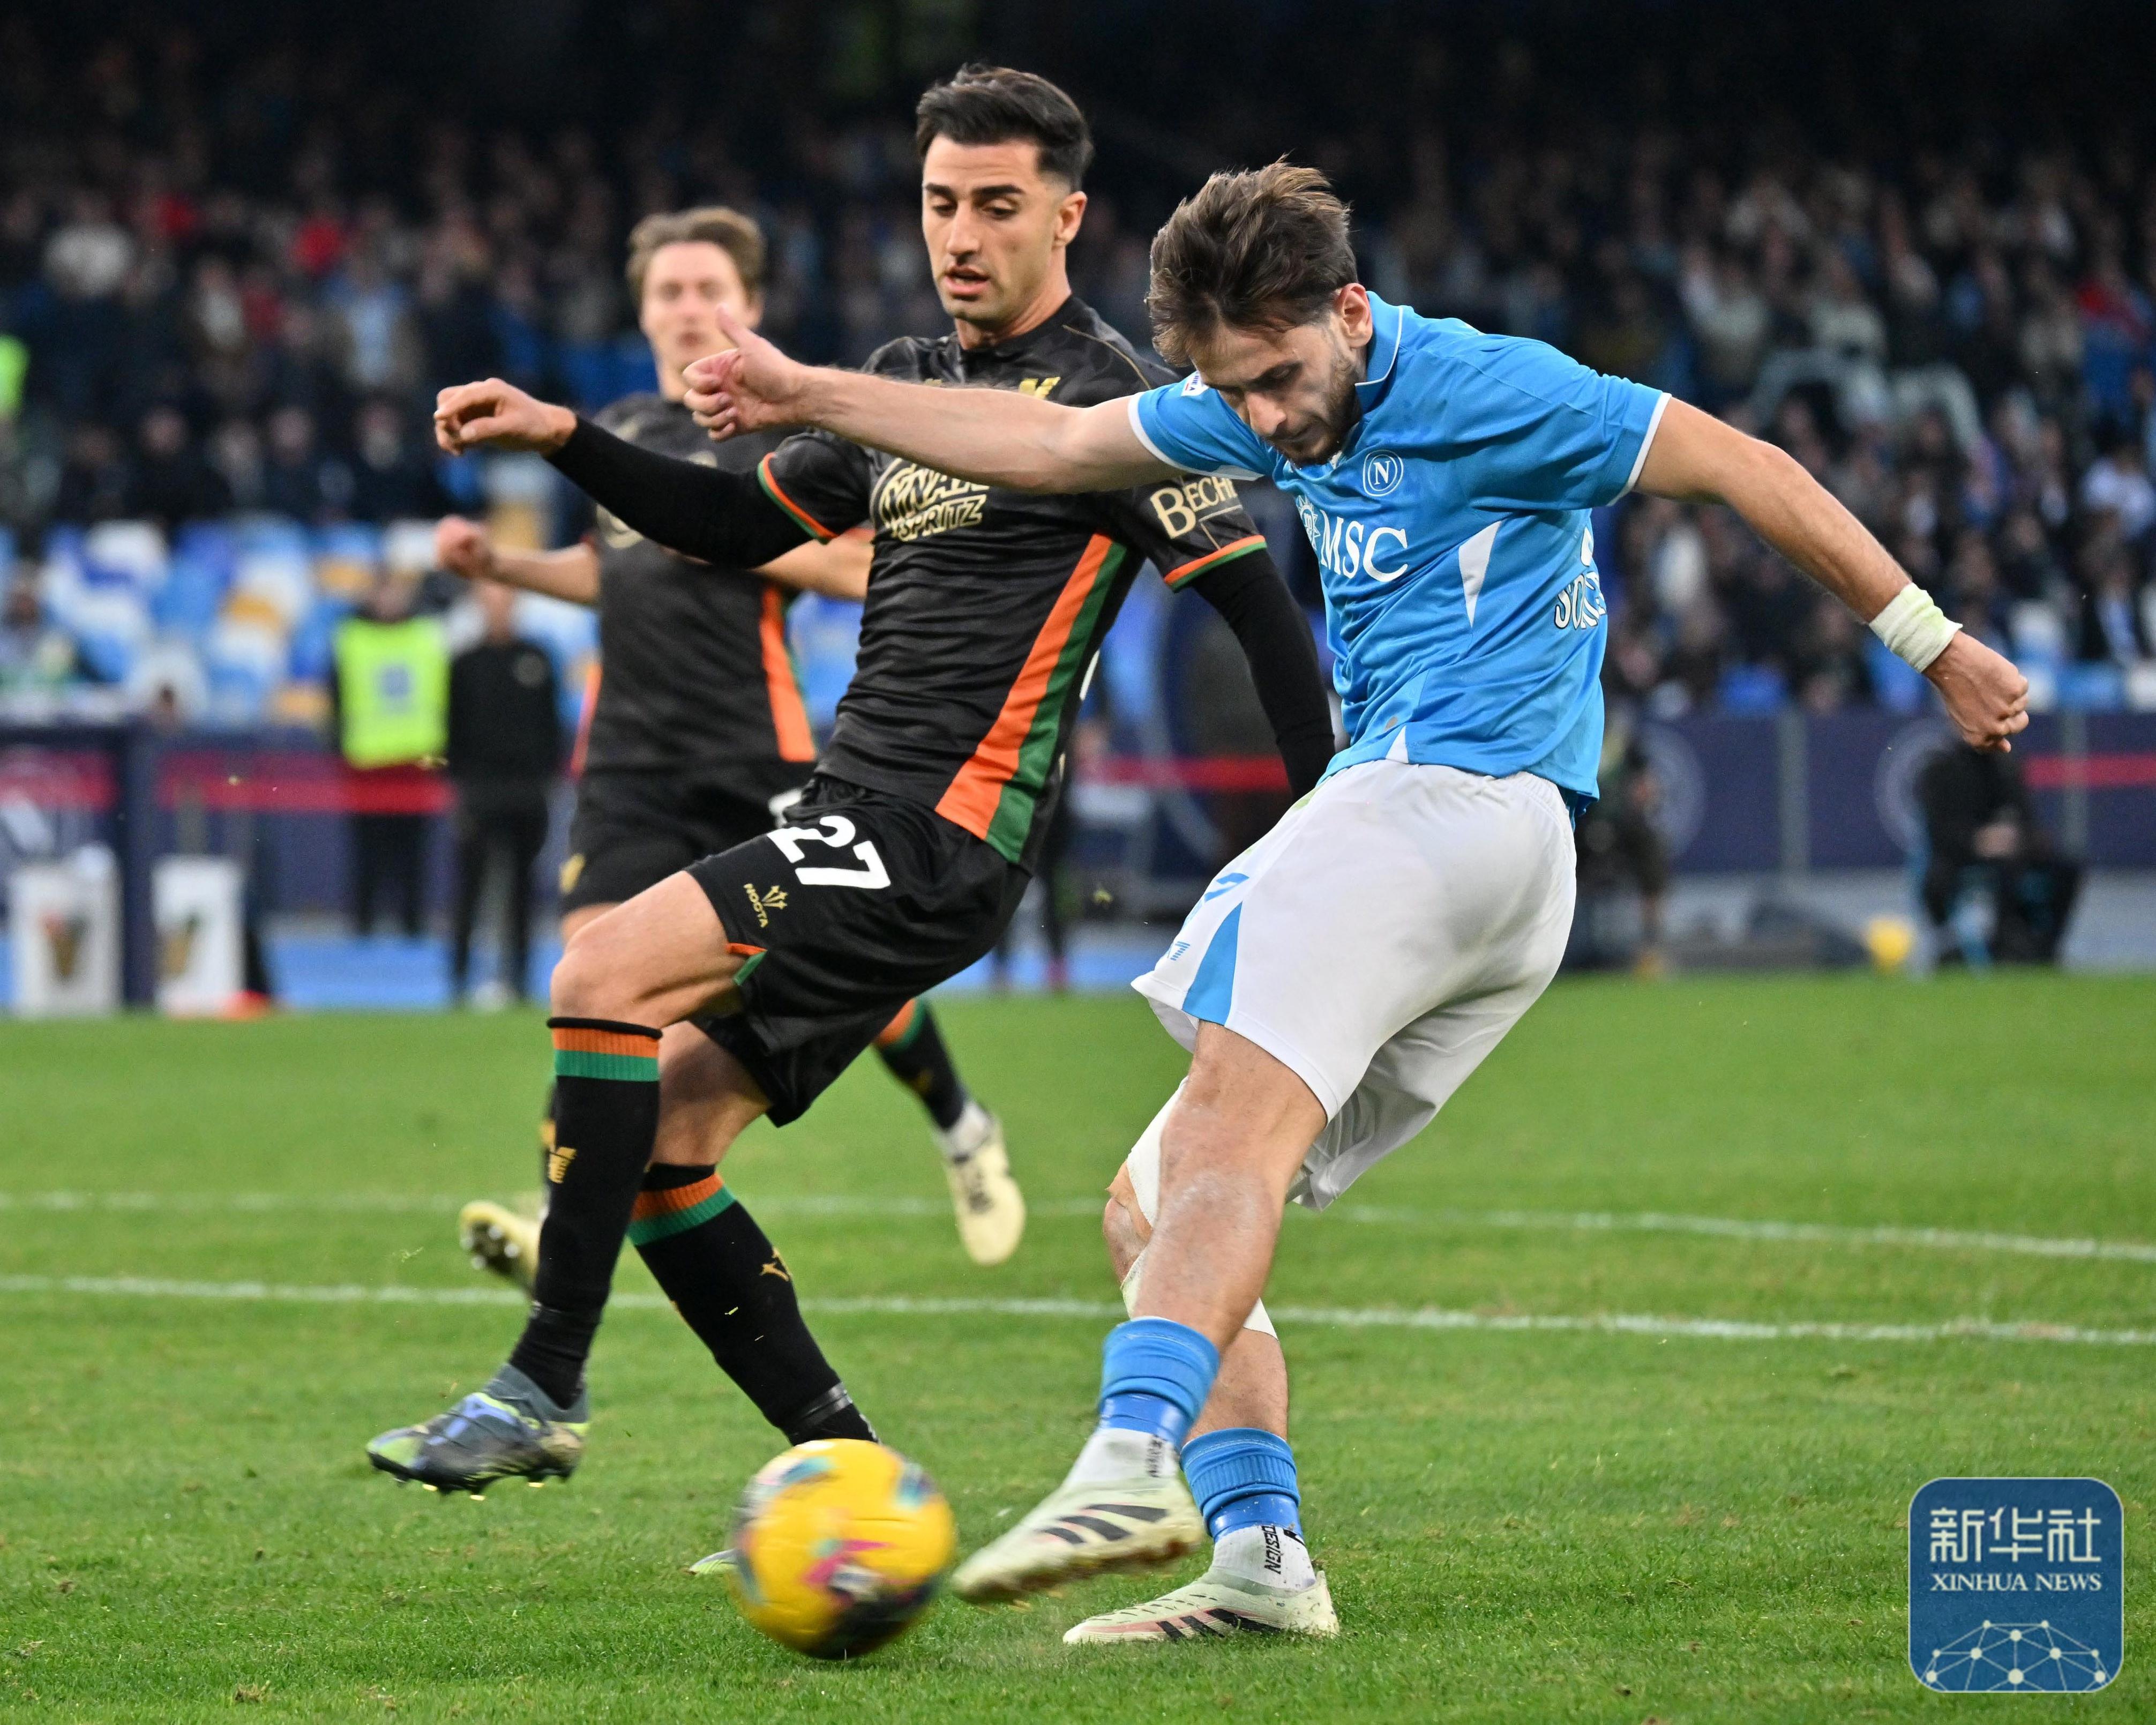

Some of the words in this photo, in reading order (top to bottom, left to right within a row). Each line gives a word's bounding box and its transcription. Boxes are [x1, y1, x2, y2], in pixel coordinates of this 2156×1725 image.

[1373, 460, 1390, 485] N
[1319, 509, 1408, 583] MSC
[766, 815, 891, 889] 27
[1261, 1525, 1281, 1575] DESIGN
